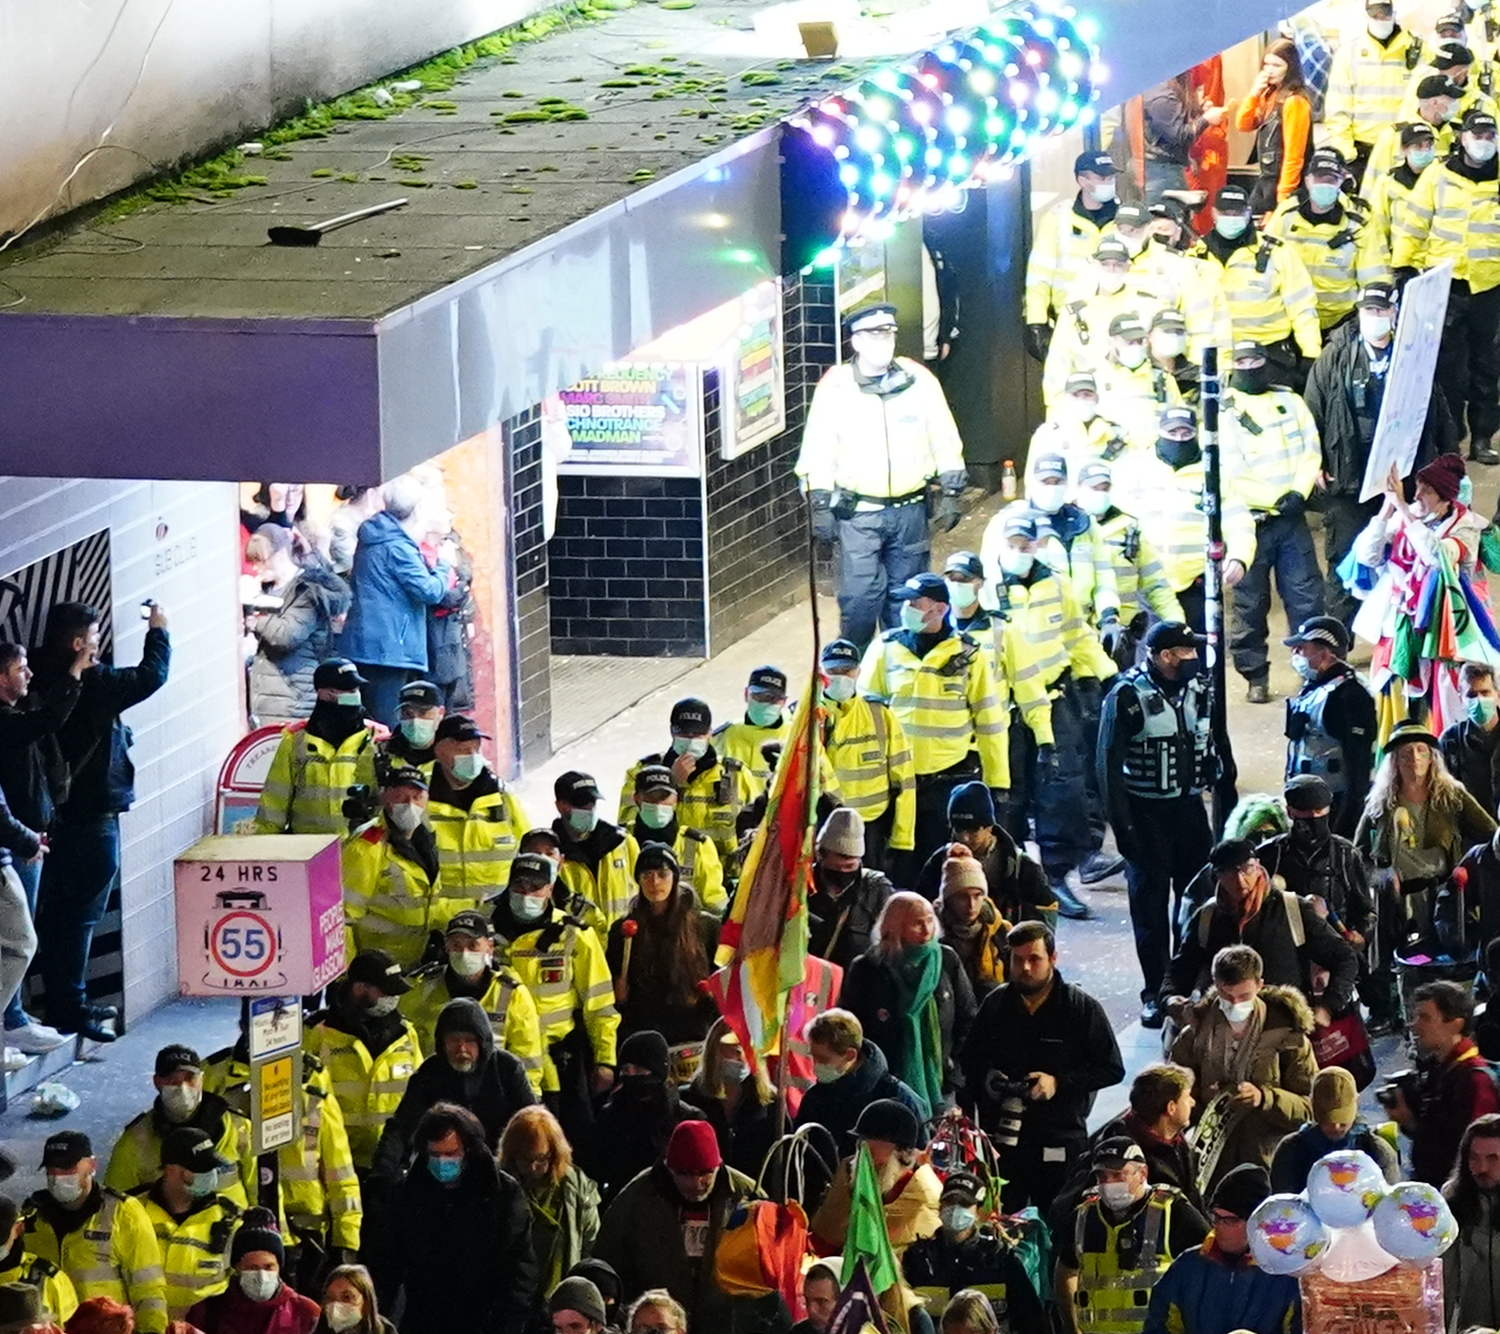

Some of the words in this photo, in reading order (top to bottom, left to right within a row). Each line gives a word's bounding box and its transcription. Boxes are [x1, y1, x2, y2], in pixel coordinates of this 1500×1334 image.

[601, 380, 656, 393] BROWN
[592, 405, 666, 419] BROTHERS
[567, 418, 663, 432] CHNOTRANCE
[573, 430, 641, 443] MADMAN
[174, 536, 197, 567] CLUB
[201, 866, 224, 883] 24
[238, 866, 278, 883] HRS
[221, 928, 265, 960] 55
